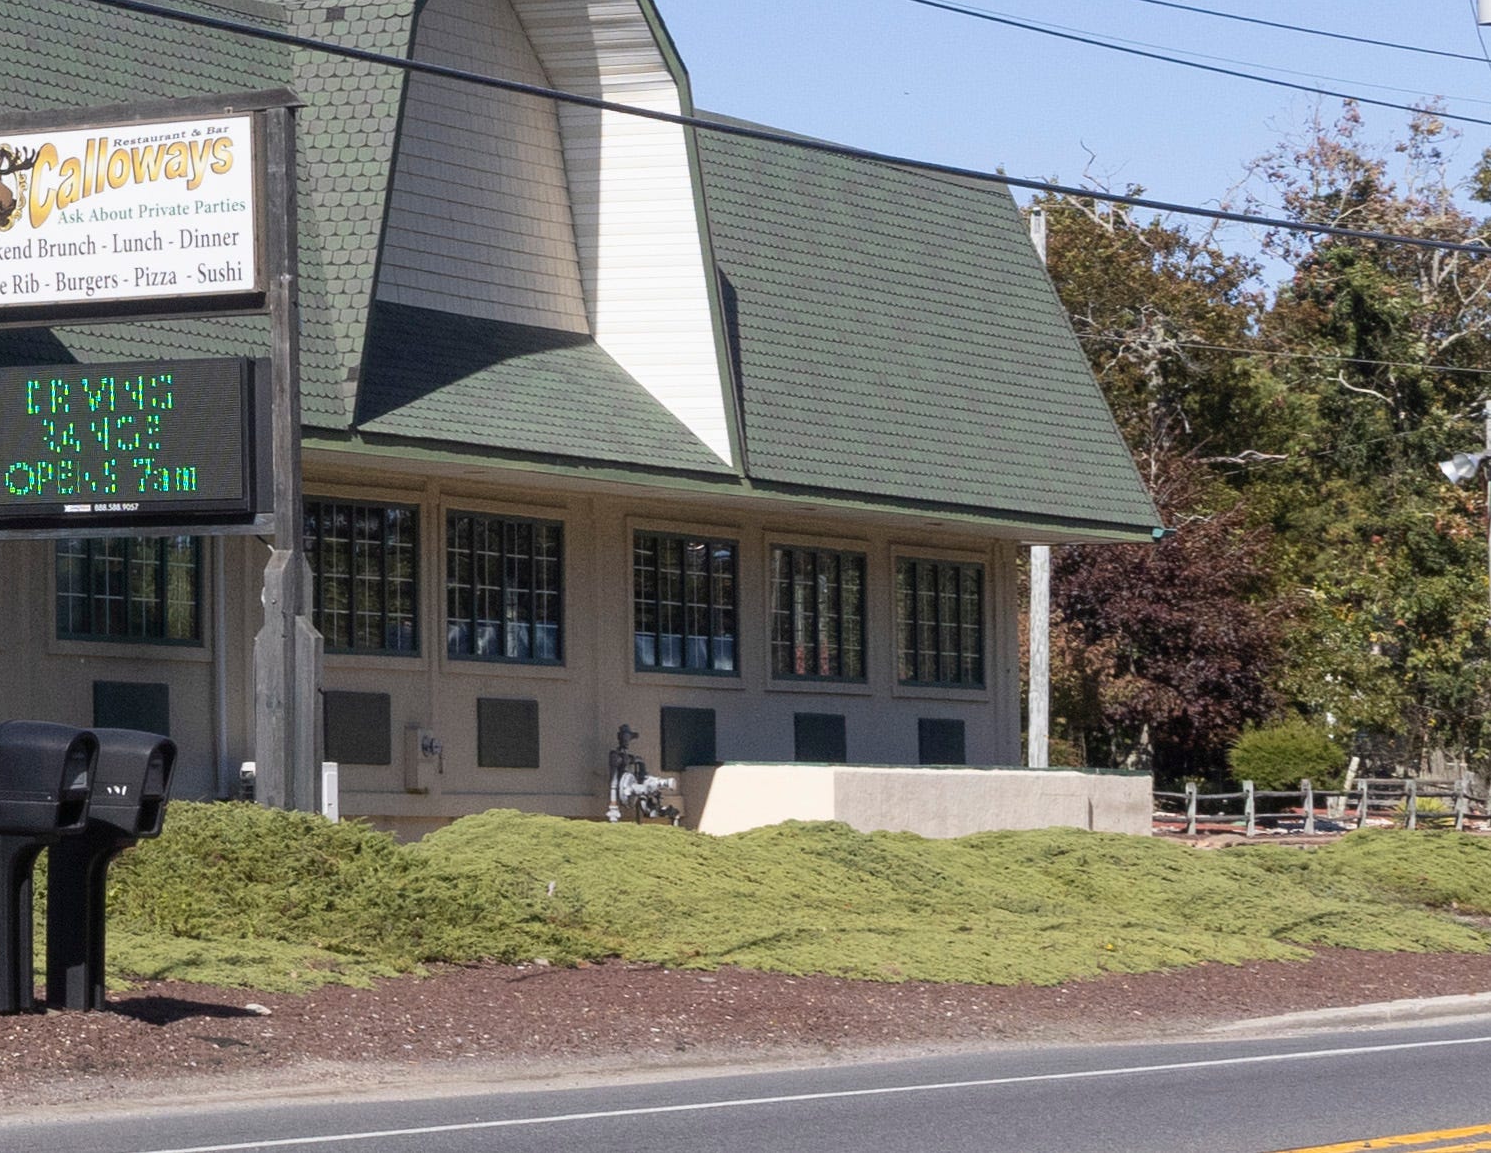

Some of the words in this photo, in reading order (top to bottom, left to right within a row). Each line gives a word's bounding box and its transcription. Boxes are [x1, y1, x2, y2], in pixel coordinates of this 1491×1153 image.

[112, 130, 187, 148] Restaurant
[190, 127, 203, 138] &
[205, 125, 231, 136] Bar
[28, 136, 235, 230] Calloways
[57, 207, 85, 225] Ask
[88, 205, 134, 223] About
[137, 202, 191, 219] Private
[194, 198, 247, 215] Parties
[37, 233, 97, 259] Brunch
[112, 229, 164, 254] Lunch
[179, 227, 240, 250] Dinner
[11, 272, 41, 295] Rib
[54, 270, 119, 297] Burgers
[134, 266, 178, 288] Pizza
[196, 260, 243, 285] Sushi
